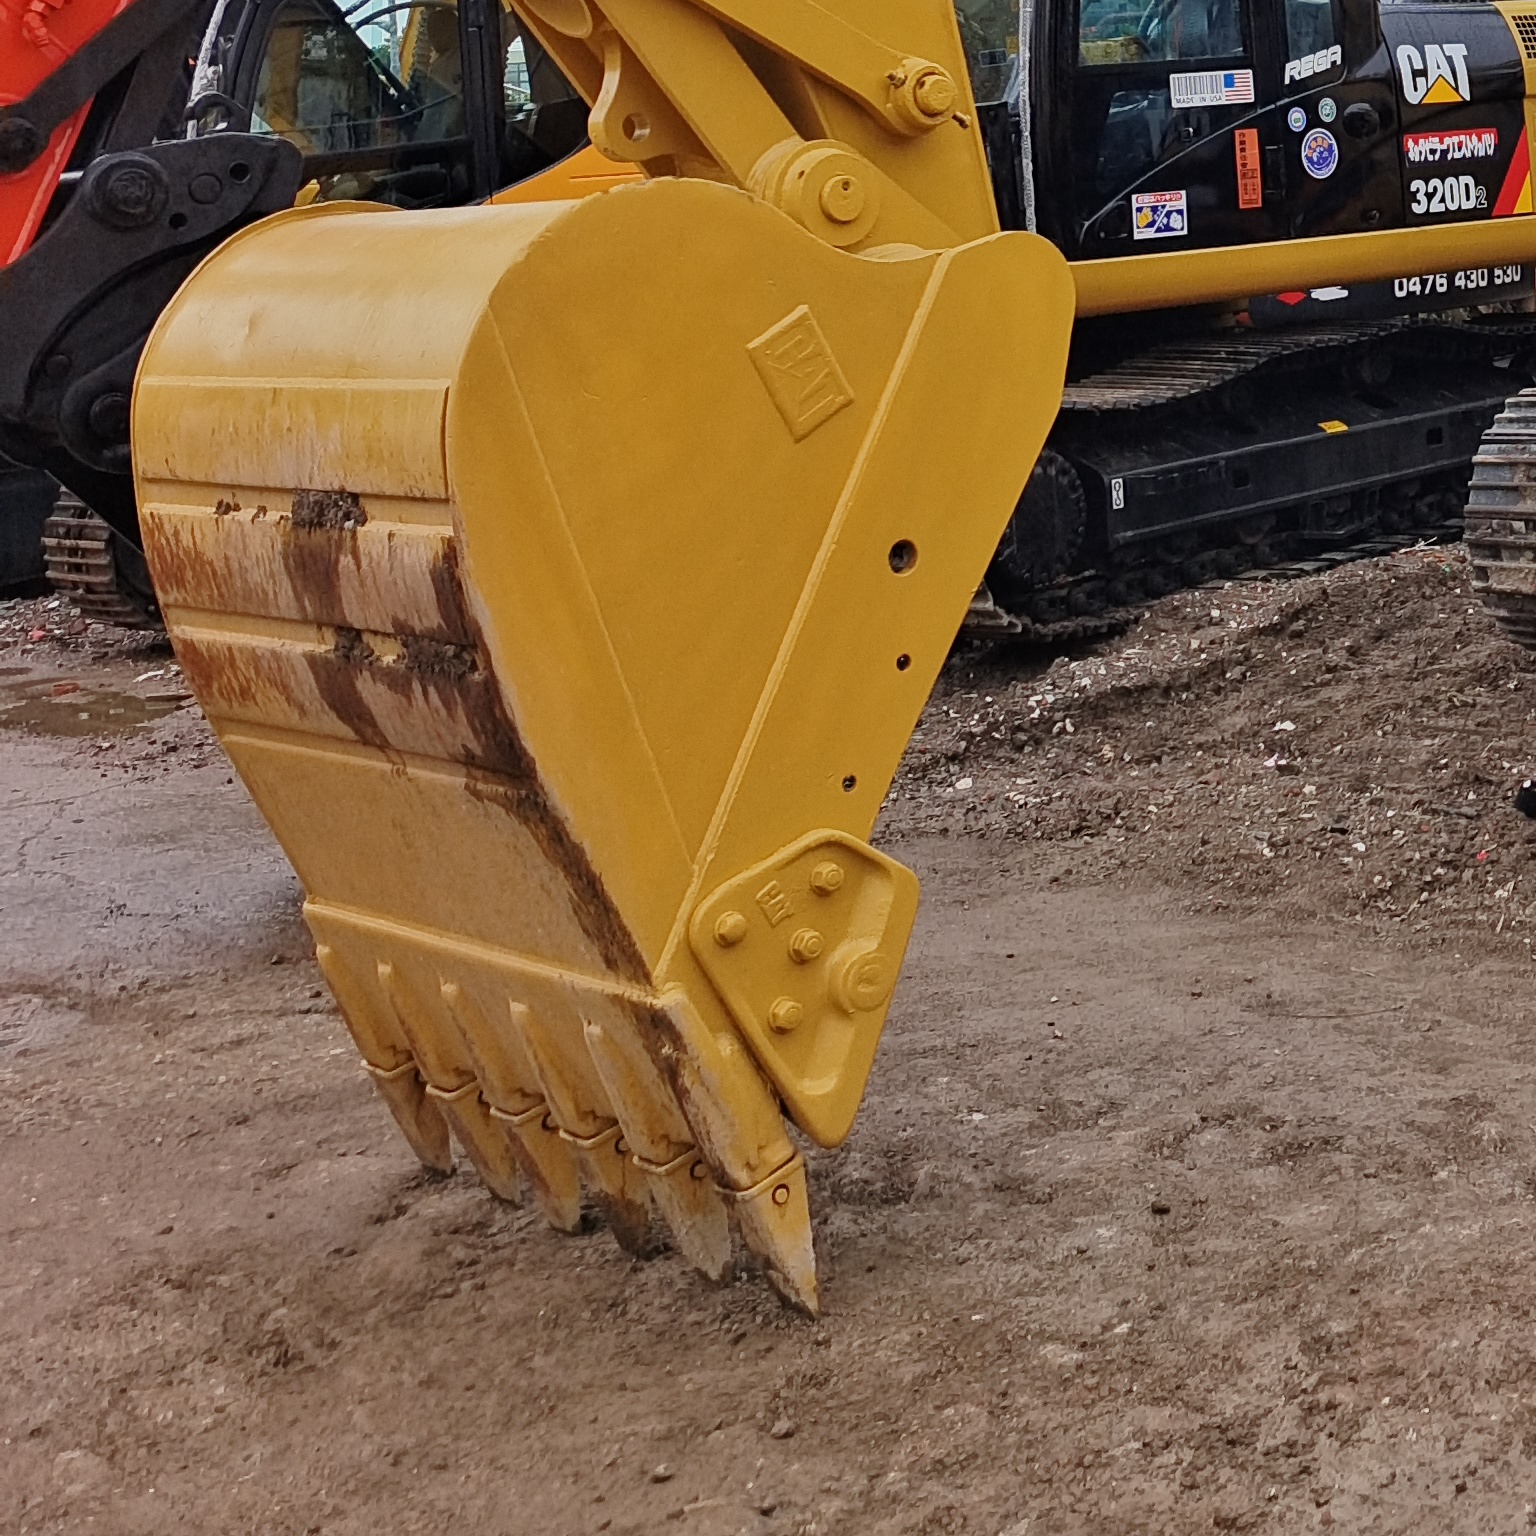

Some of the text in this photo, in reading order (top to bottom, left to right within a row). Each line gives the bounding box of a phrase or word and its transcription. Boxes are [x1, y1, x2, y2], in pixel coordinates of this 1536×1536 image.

[1284, 44, 1342, 85] REGA
[1396, 44, 1471, 105] CAT
[1394, 264, 1521, 298] 0476 430 530
